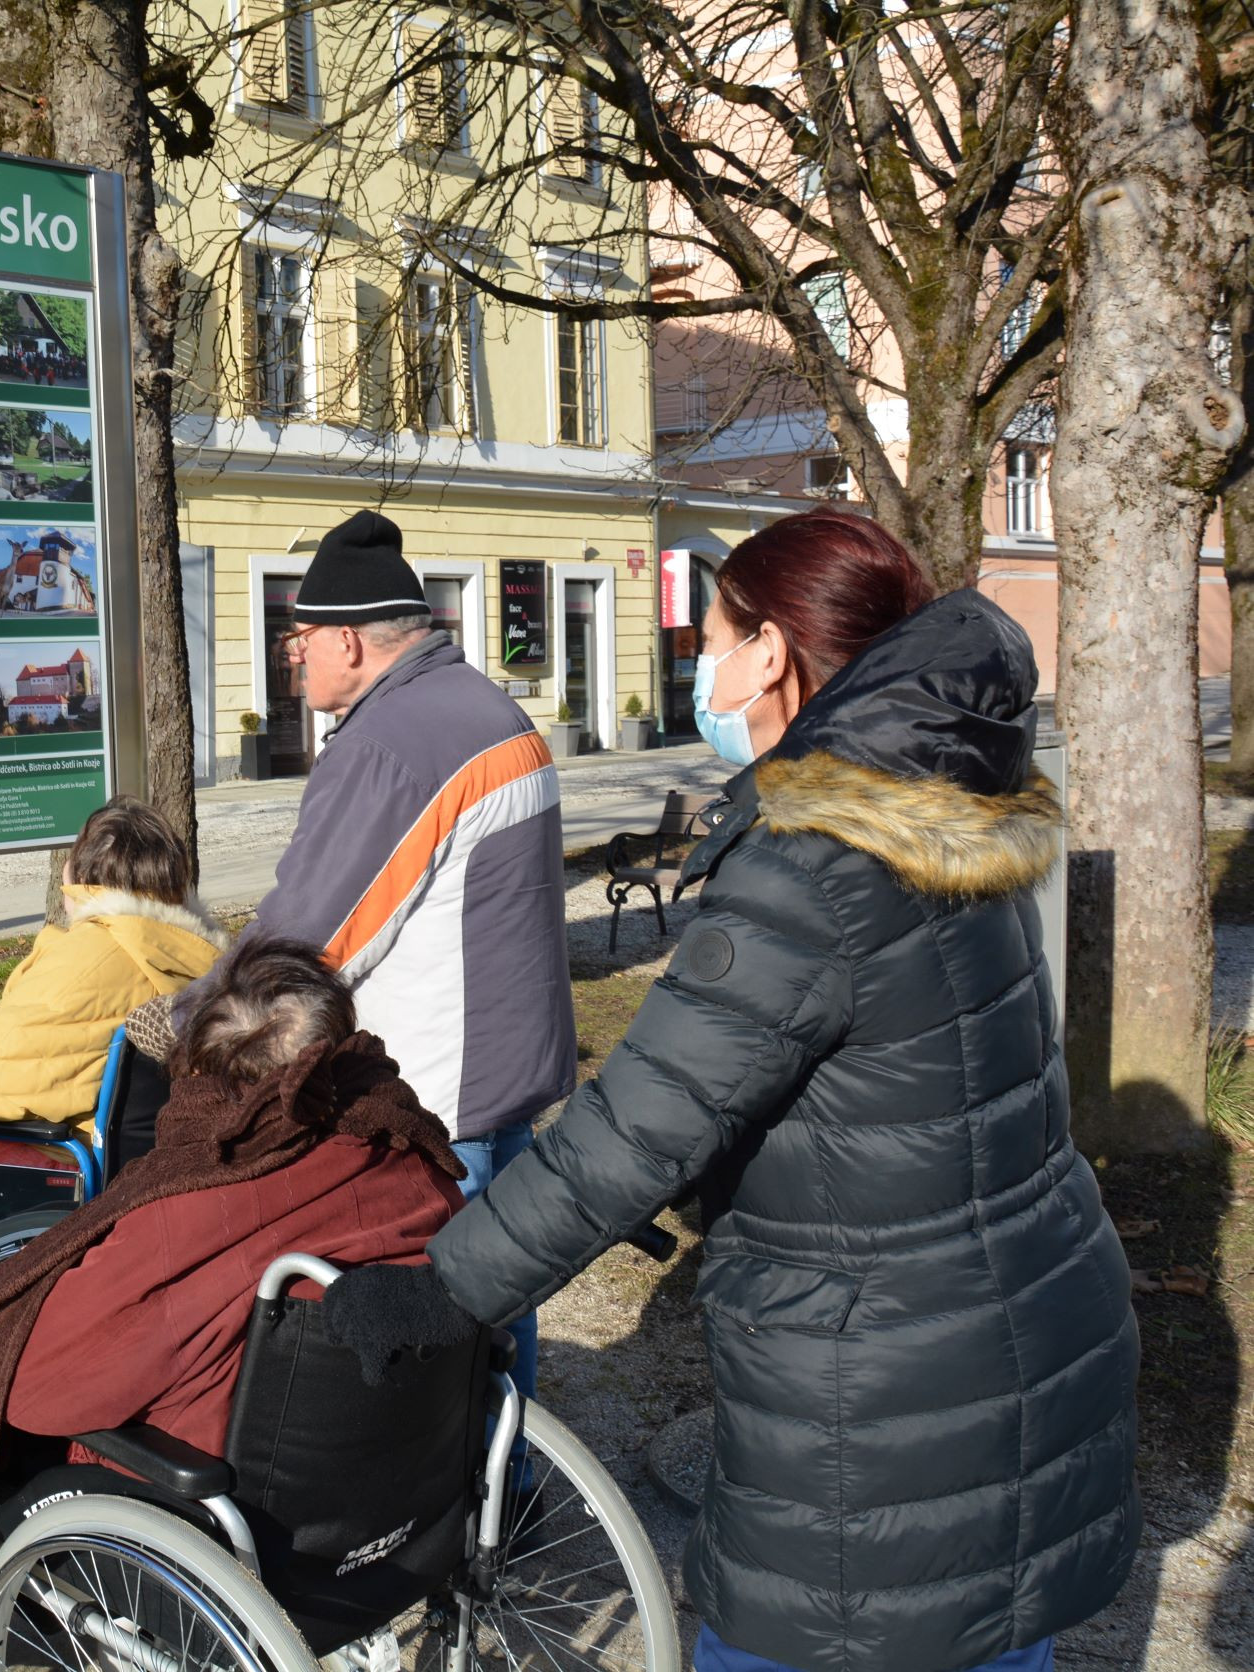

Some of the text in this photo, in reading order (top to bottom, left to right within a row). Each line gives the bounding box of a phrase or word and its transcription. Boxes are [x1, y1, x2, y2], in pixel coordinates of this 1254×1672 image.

[29, 763, 52, 772] Bistrica
[52, 762, 61, 771] ob
[62, 760, 76, 770] Sotli
[76, 760, 83, 768] in
[83, 758, 101, 769] Kozje
[342, 1516, 417, 1562] MEYRA
